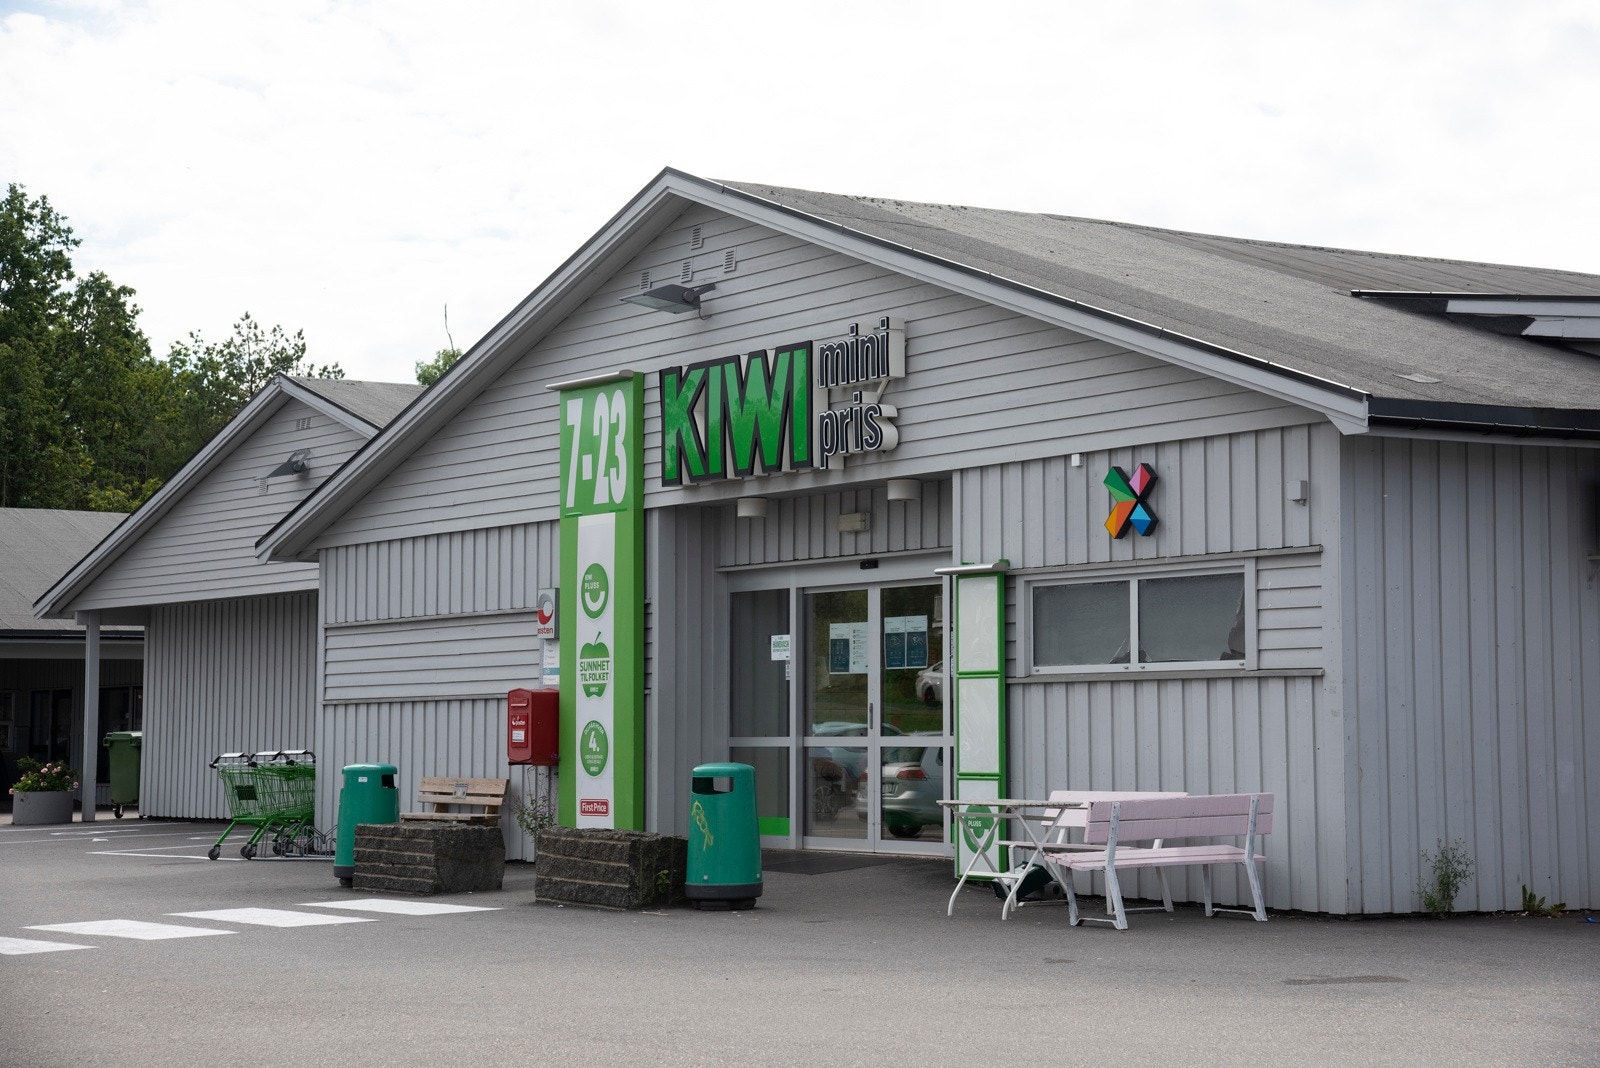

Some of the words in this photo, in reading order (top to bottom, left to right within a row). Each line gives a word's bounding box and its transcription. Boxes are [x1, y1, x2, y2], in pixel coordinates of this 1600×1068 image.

[817, 316, 890, 389] mini
[565, 389, 628, 509] 7-23
[659, 340, 813, 487] KIWI
[817, 390, 882, 470] pris
[579, 659, 610, 672] SUNNHET
[589, 671, 609, 682] FOLKET
[581, 801, 594, 812] First
[594, 800, 607, 813] Price
